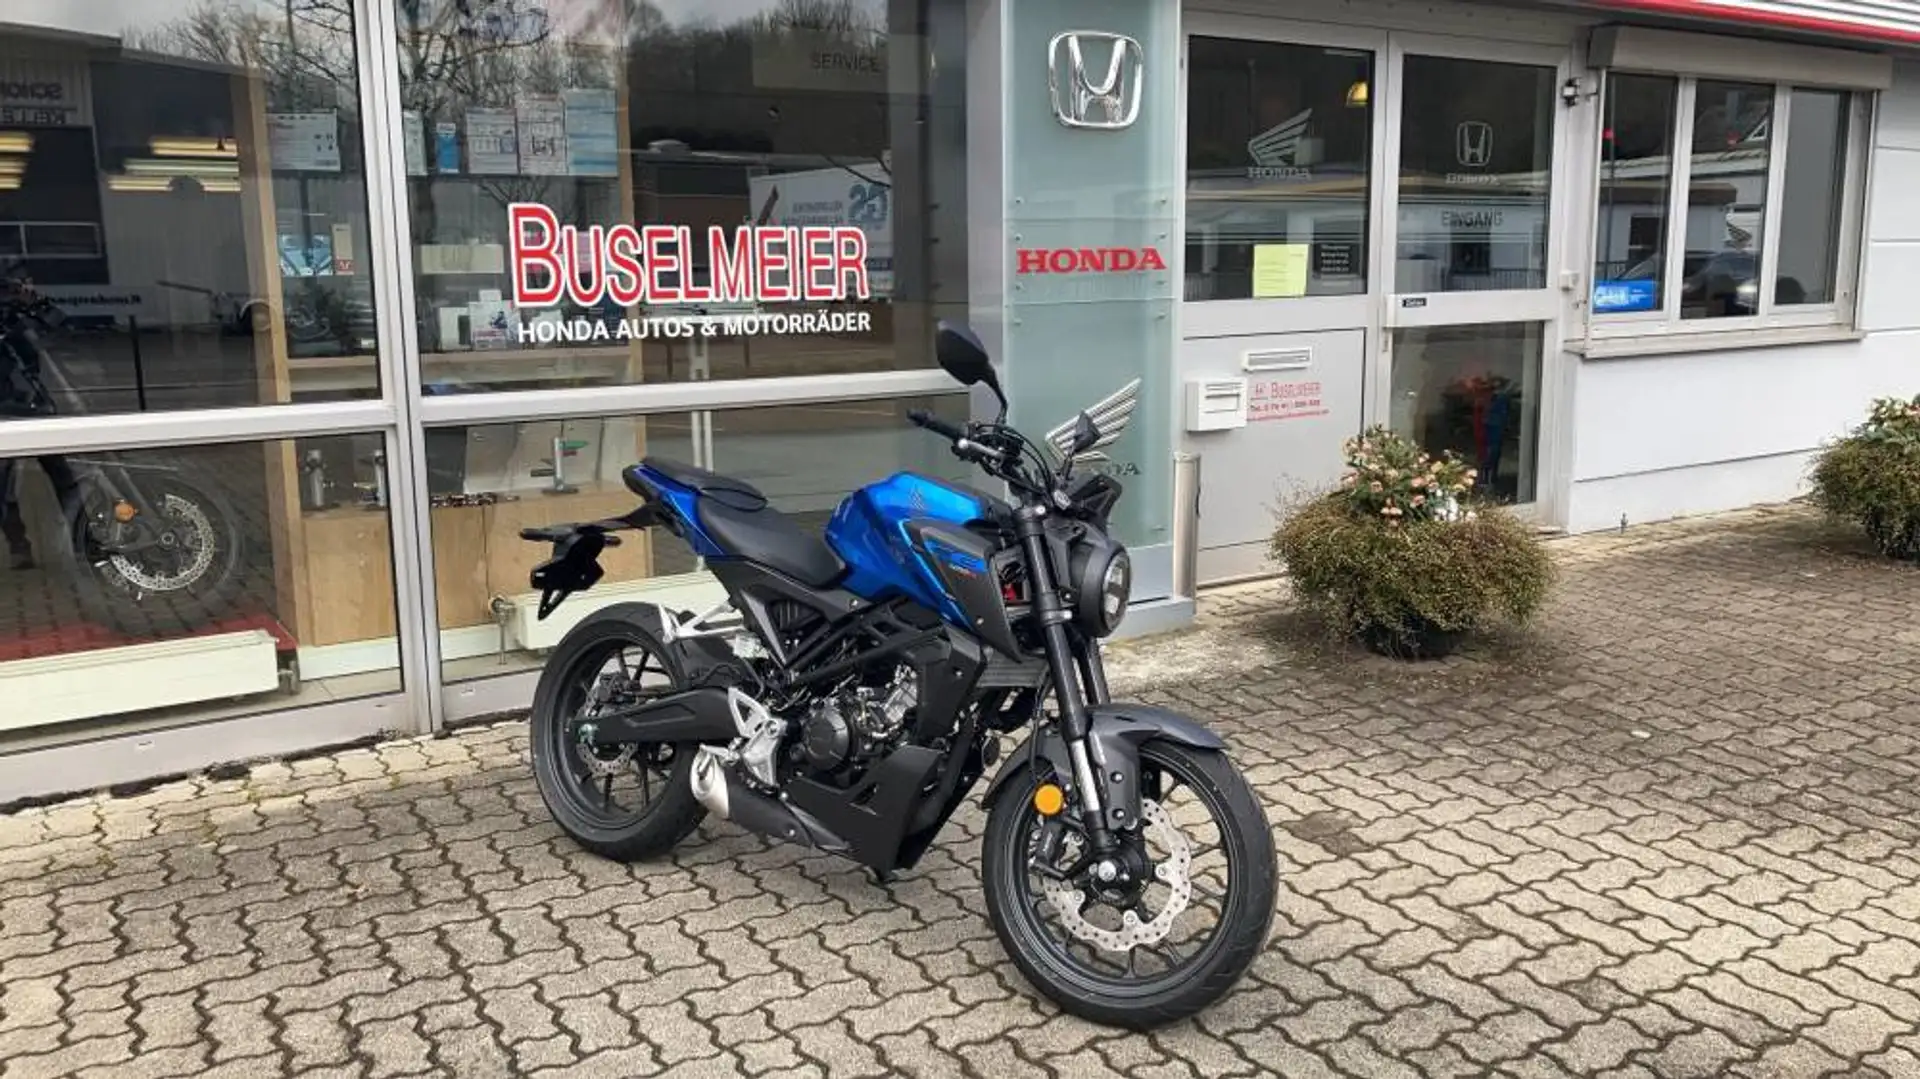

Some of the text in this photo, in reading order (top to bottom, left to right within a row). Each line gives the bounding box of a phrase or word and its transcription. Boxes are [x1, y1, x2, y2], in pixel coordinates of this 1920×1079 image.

[813, 53, 880, 73] SERVICE
[1248, 166, 1311, 181] HONDA
[1441, 210, 1503, 228] EINGANG
[508, 202, 870, 308] BUSELMEIER
[1016, 248, 1167, 274] HONDA
[518, 319, 610, 344] HONDA
[615, 316, 694, 340] AUTOS
[700, 317, 717, 338] &
[723, 309, 871, 337] MOTORRÄDER
